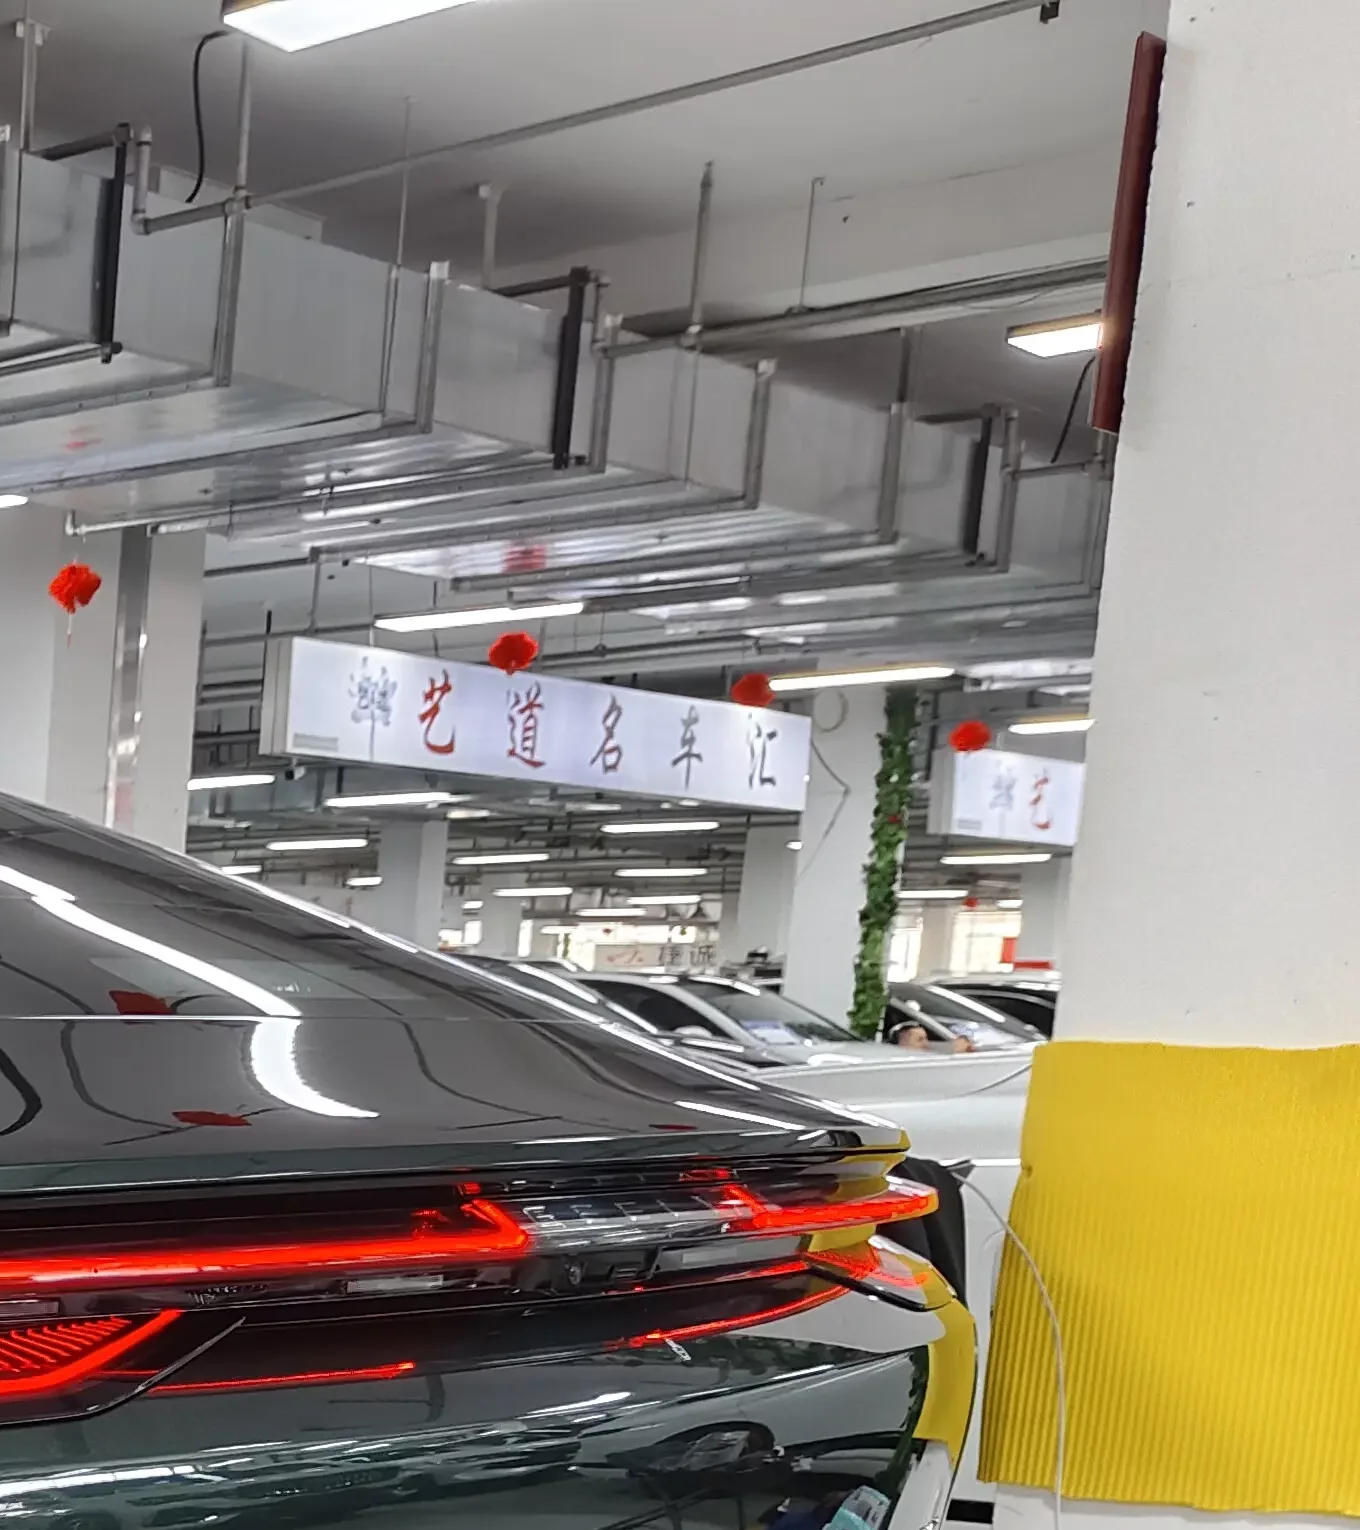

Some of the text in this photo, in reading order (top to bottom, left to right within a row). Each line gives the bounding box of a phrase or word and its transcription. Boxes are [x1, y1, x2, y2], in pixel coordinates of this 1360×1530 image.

[418, 668, 778, 789] 艺道名车汇
